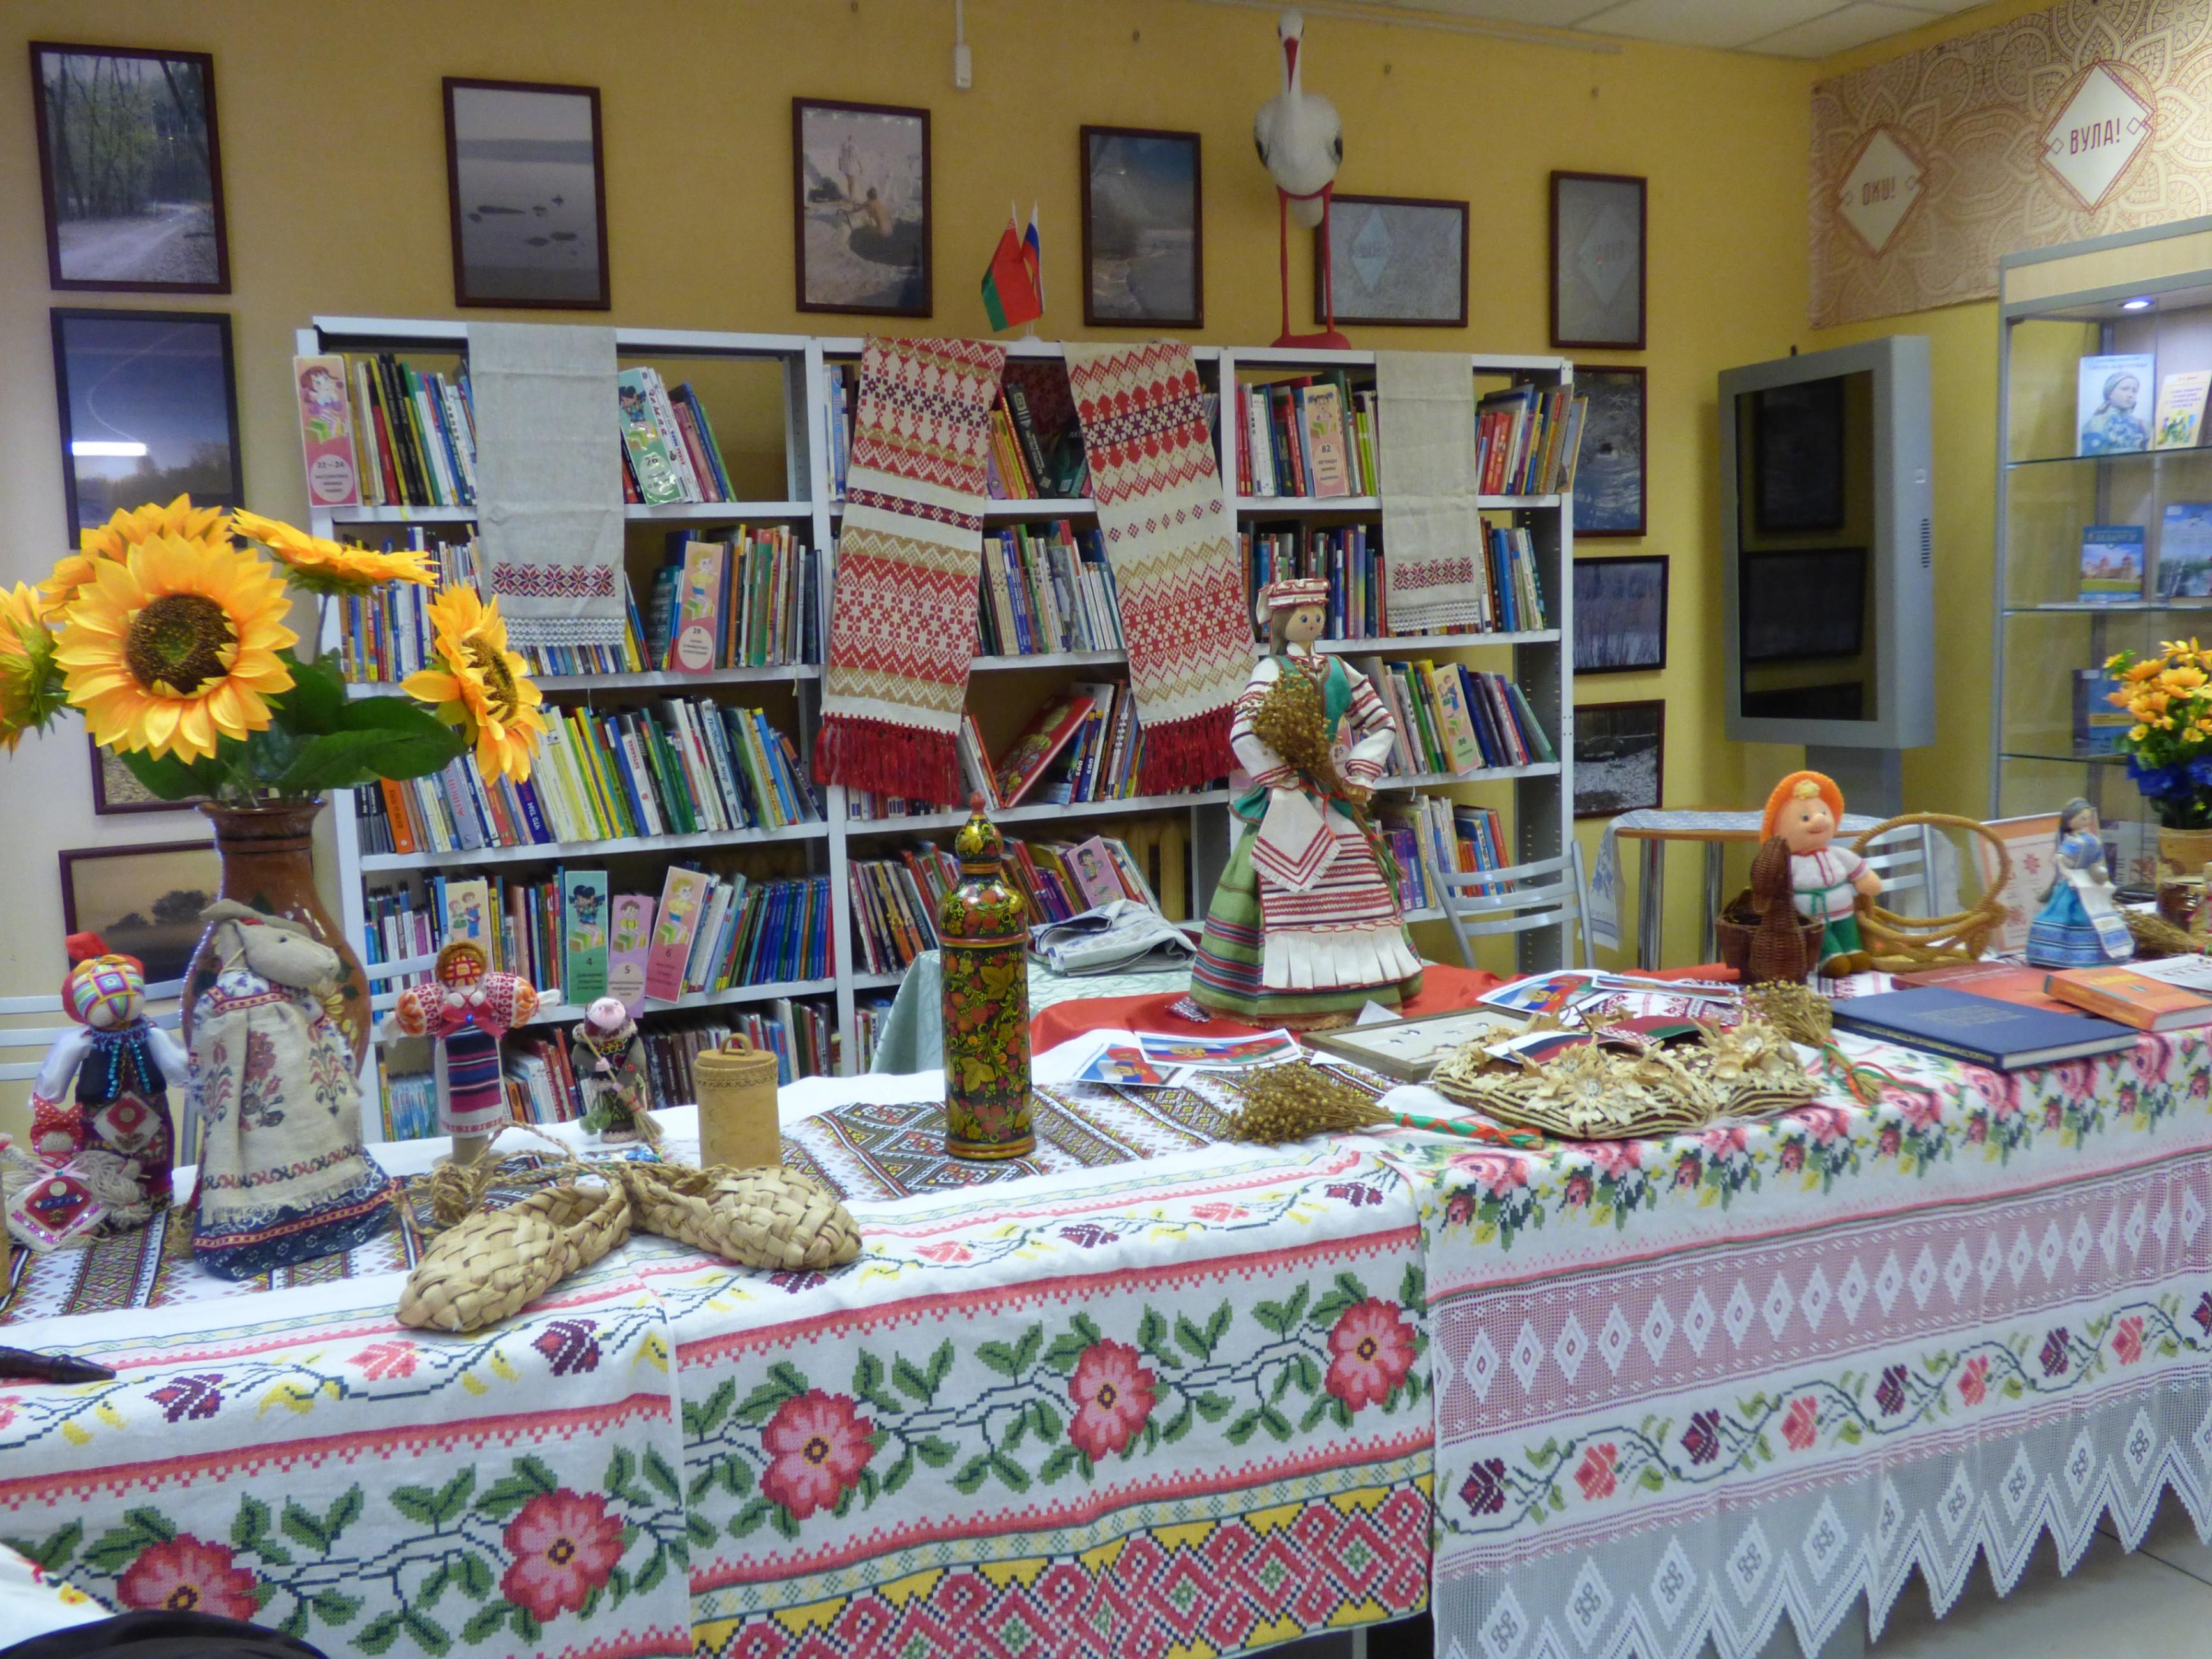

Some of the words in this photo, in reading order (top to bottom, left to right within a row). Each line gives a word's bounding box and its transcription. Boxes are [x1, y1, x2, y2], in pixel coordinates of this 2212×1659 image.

[2070, 117, 2119, 154] ВУЛА!
[1321, 444, 1331, 453] 82
[707, 717, 725, 762] Подводный
[720, 765, 729, 782] мир
[527, 802, 536, 816] ТАМ
[530, 817, 541, 830] ЧТО
[666, 949, 671, 957] 6
[586, 957, 592, 966] 4
[624, 965, 630, 974] 5
